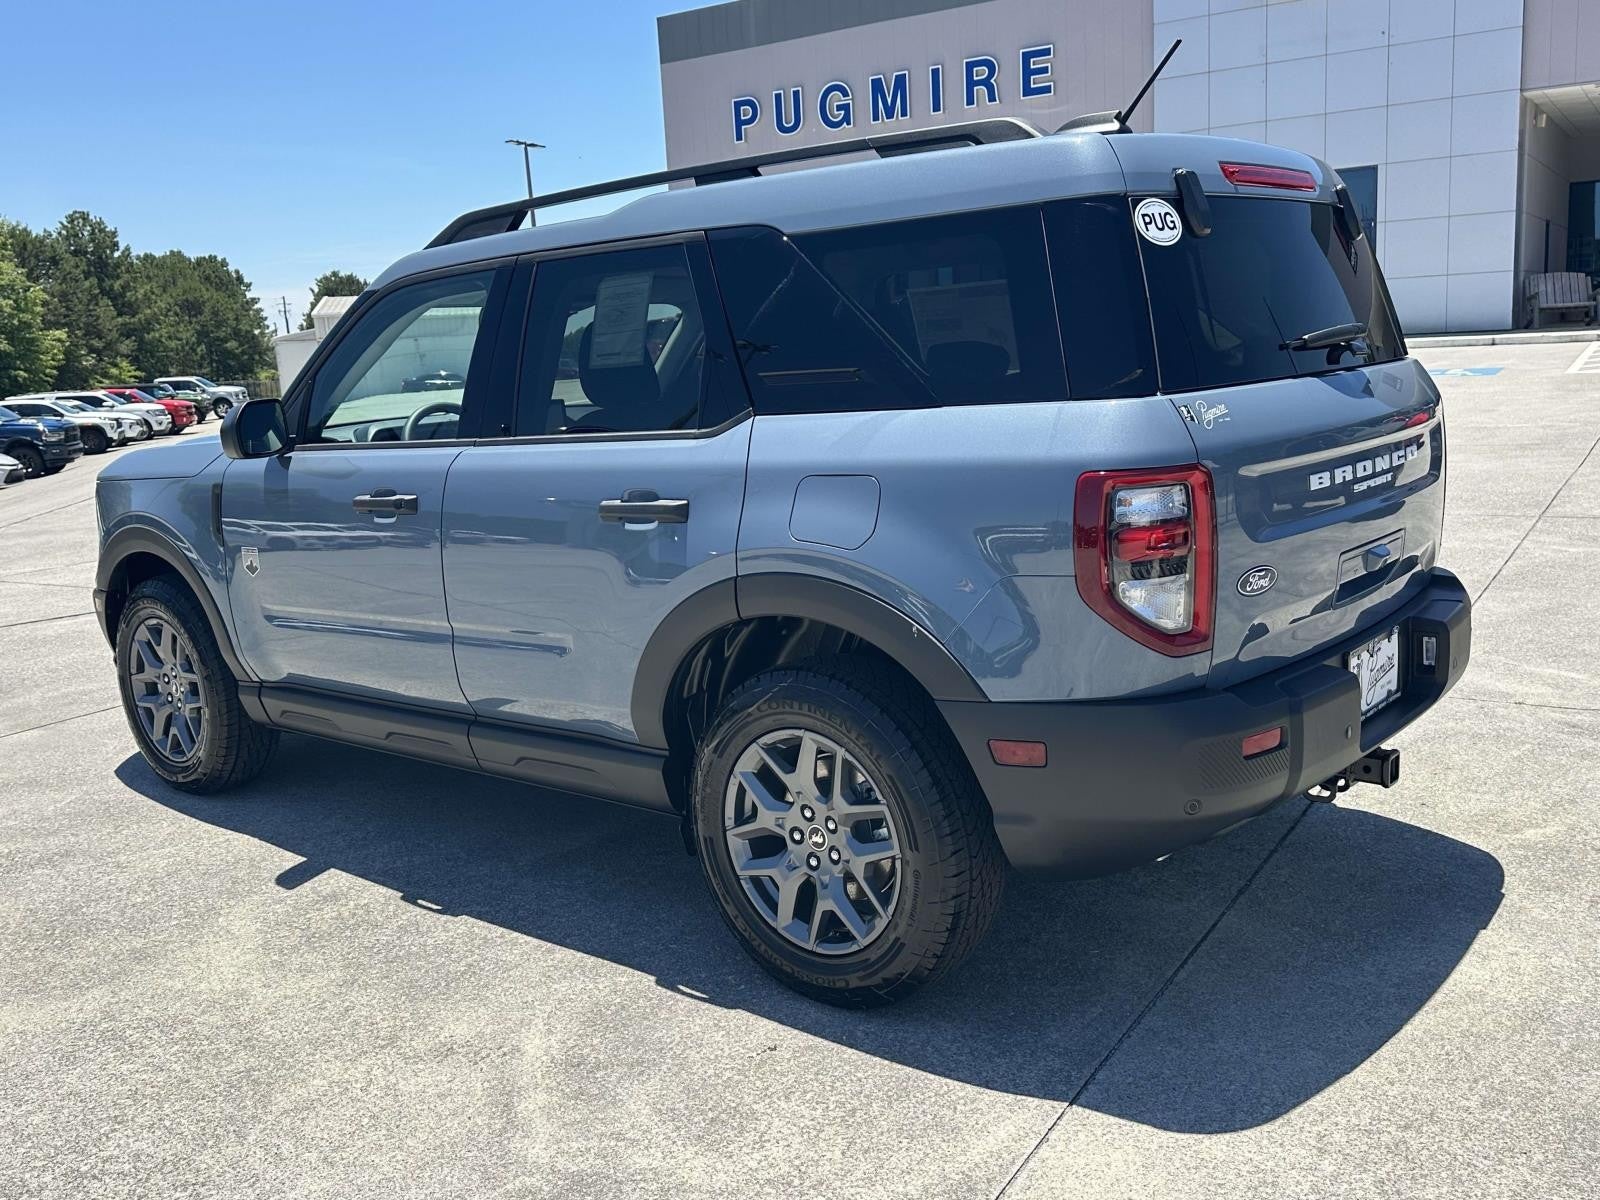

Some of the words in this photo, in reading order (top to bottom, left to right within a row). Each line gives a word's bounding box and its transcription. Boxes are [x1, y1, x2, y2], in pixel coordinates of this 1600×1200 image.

[732, 44, 1055, 144] PUGMIRE
[1141, 211, 1178, 232] PUG
[1308, 444, 1418, 491] BRONCO
[1353, 472, 1394, 493] SPORT
[1246, 570, 1271, 592] Ford
